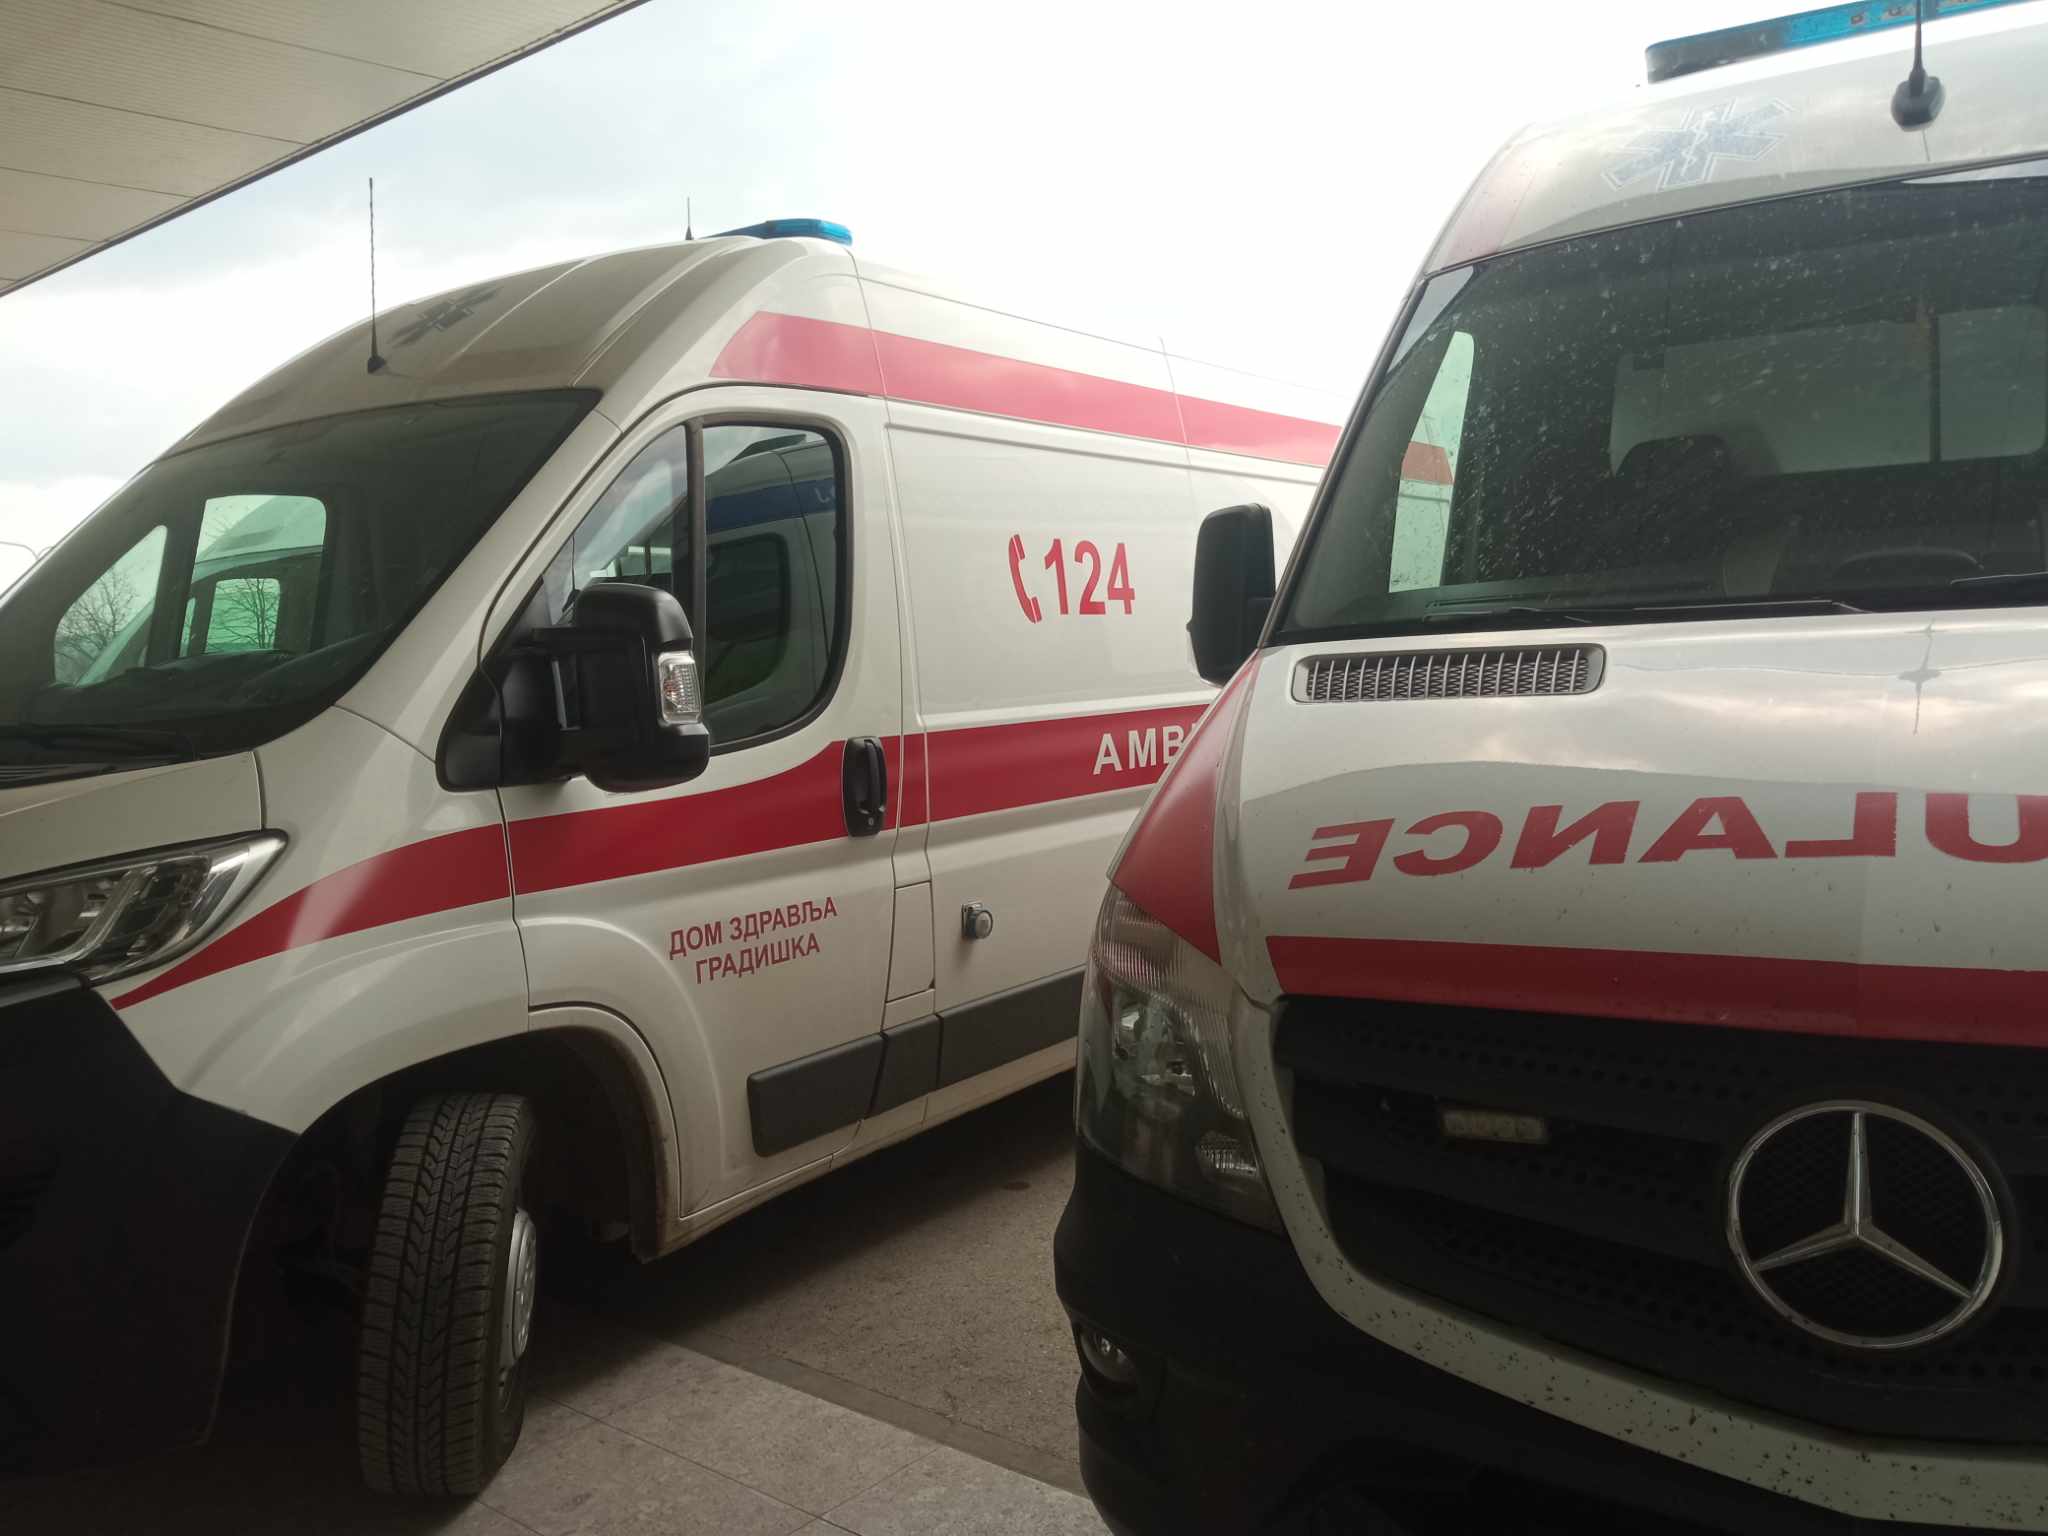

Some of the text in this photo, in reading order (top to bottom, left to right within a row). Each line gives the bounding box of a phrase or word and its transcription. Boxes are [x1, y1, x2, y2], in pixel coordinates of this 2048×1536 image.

[1043, 538, 1136, 615] 124
[1093, 723, 1196, 775] AMB
[669, 896, 838, 960] ДОМ ЗДРАВЉА
[695, 932, 820, 985] ГРАДИШКА
